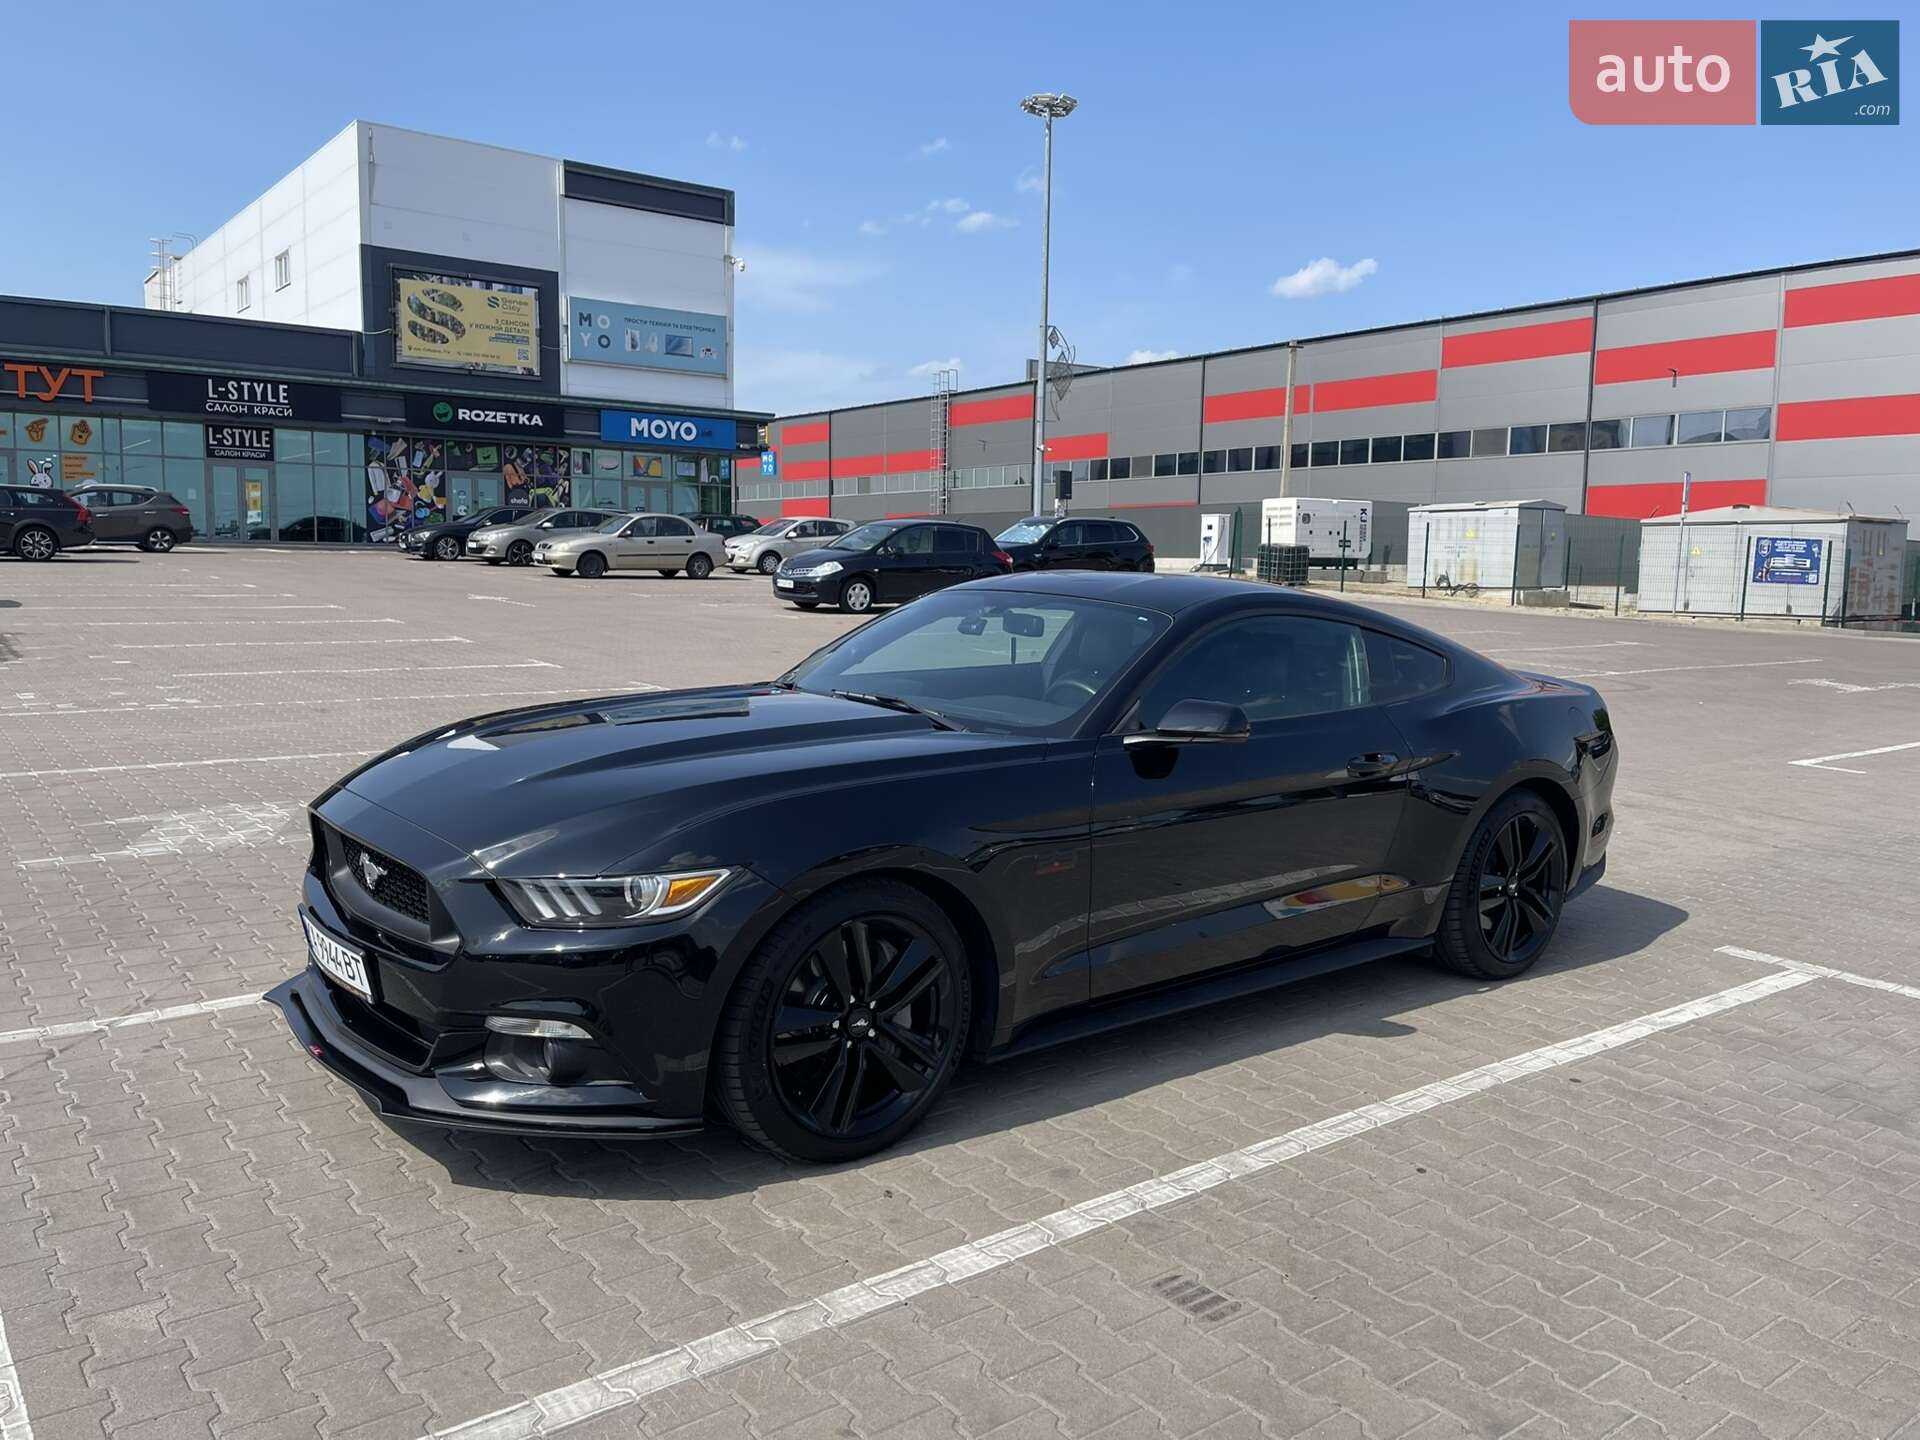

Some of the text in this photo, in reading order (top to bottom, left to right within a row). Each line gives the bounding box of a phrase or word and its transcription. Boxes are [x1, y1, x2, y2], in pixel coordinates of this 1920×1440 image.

[4, 363, 104, 402] ТУТ
[207, 378, 289, 404] L-STYLE
[205, 402, 293, 417] САЛОН КРАСИ
[457, 408, 543, 426] ROZETKA
[208, 426, 271, 448] L-STYLE
[630, 417, 697, 441] MOYO
[214, 449, 267, 459] САЛОН КРАСИ
